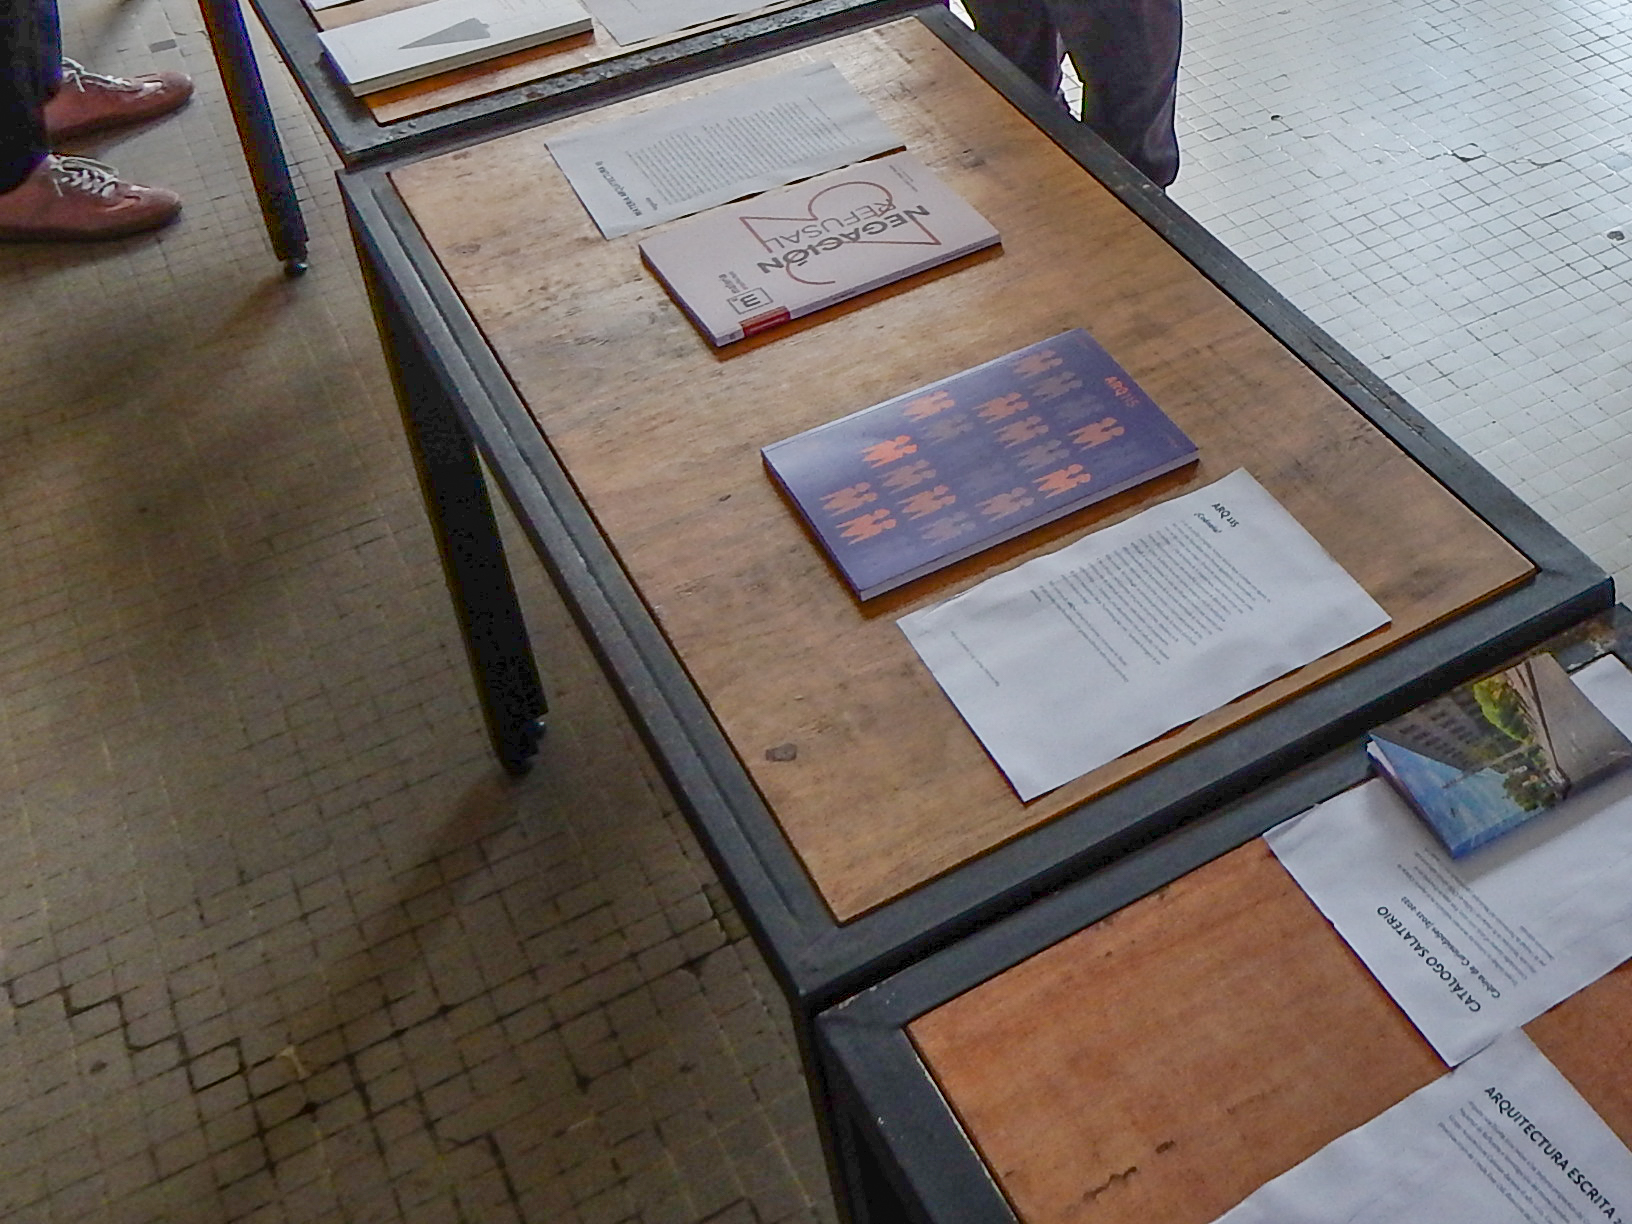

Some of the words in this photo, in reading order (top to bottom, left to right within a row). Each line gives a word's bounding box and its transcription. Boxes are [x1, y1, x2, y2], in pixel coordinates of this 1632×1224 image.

[757, 205, 930, 274] NEGACIÓN
[765, 199, 896, 248] REFUSAL
[1211, 502, 1231, 519] ARQ
[1226, 516, 1240, 528] 115
[1377, 906, 1430, 957] SALATERIO
[1432, 926, 1470, 966] Curiosidades
[1426, 957, 1481, 1012] CATÁLOGO
[1469, 965, 1479, 975] de
[1478, 975, 1501, 999] Cabina
[1484, 1086, 1568, 1172] ARQUITECTURA
[1566, 1167, 1616, 1220] ESCRITA
